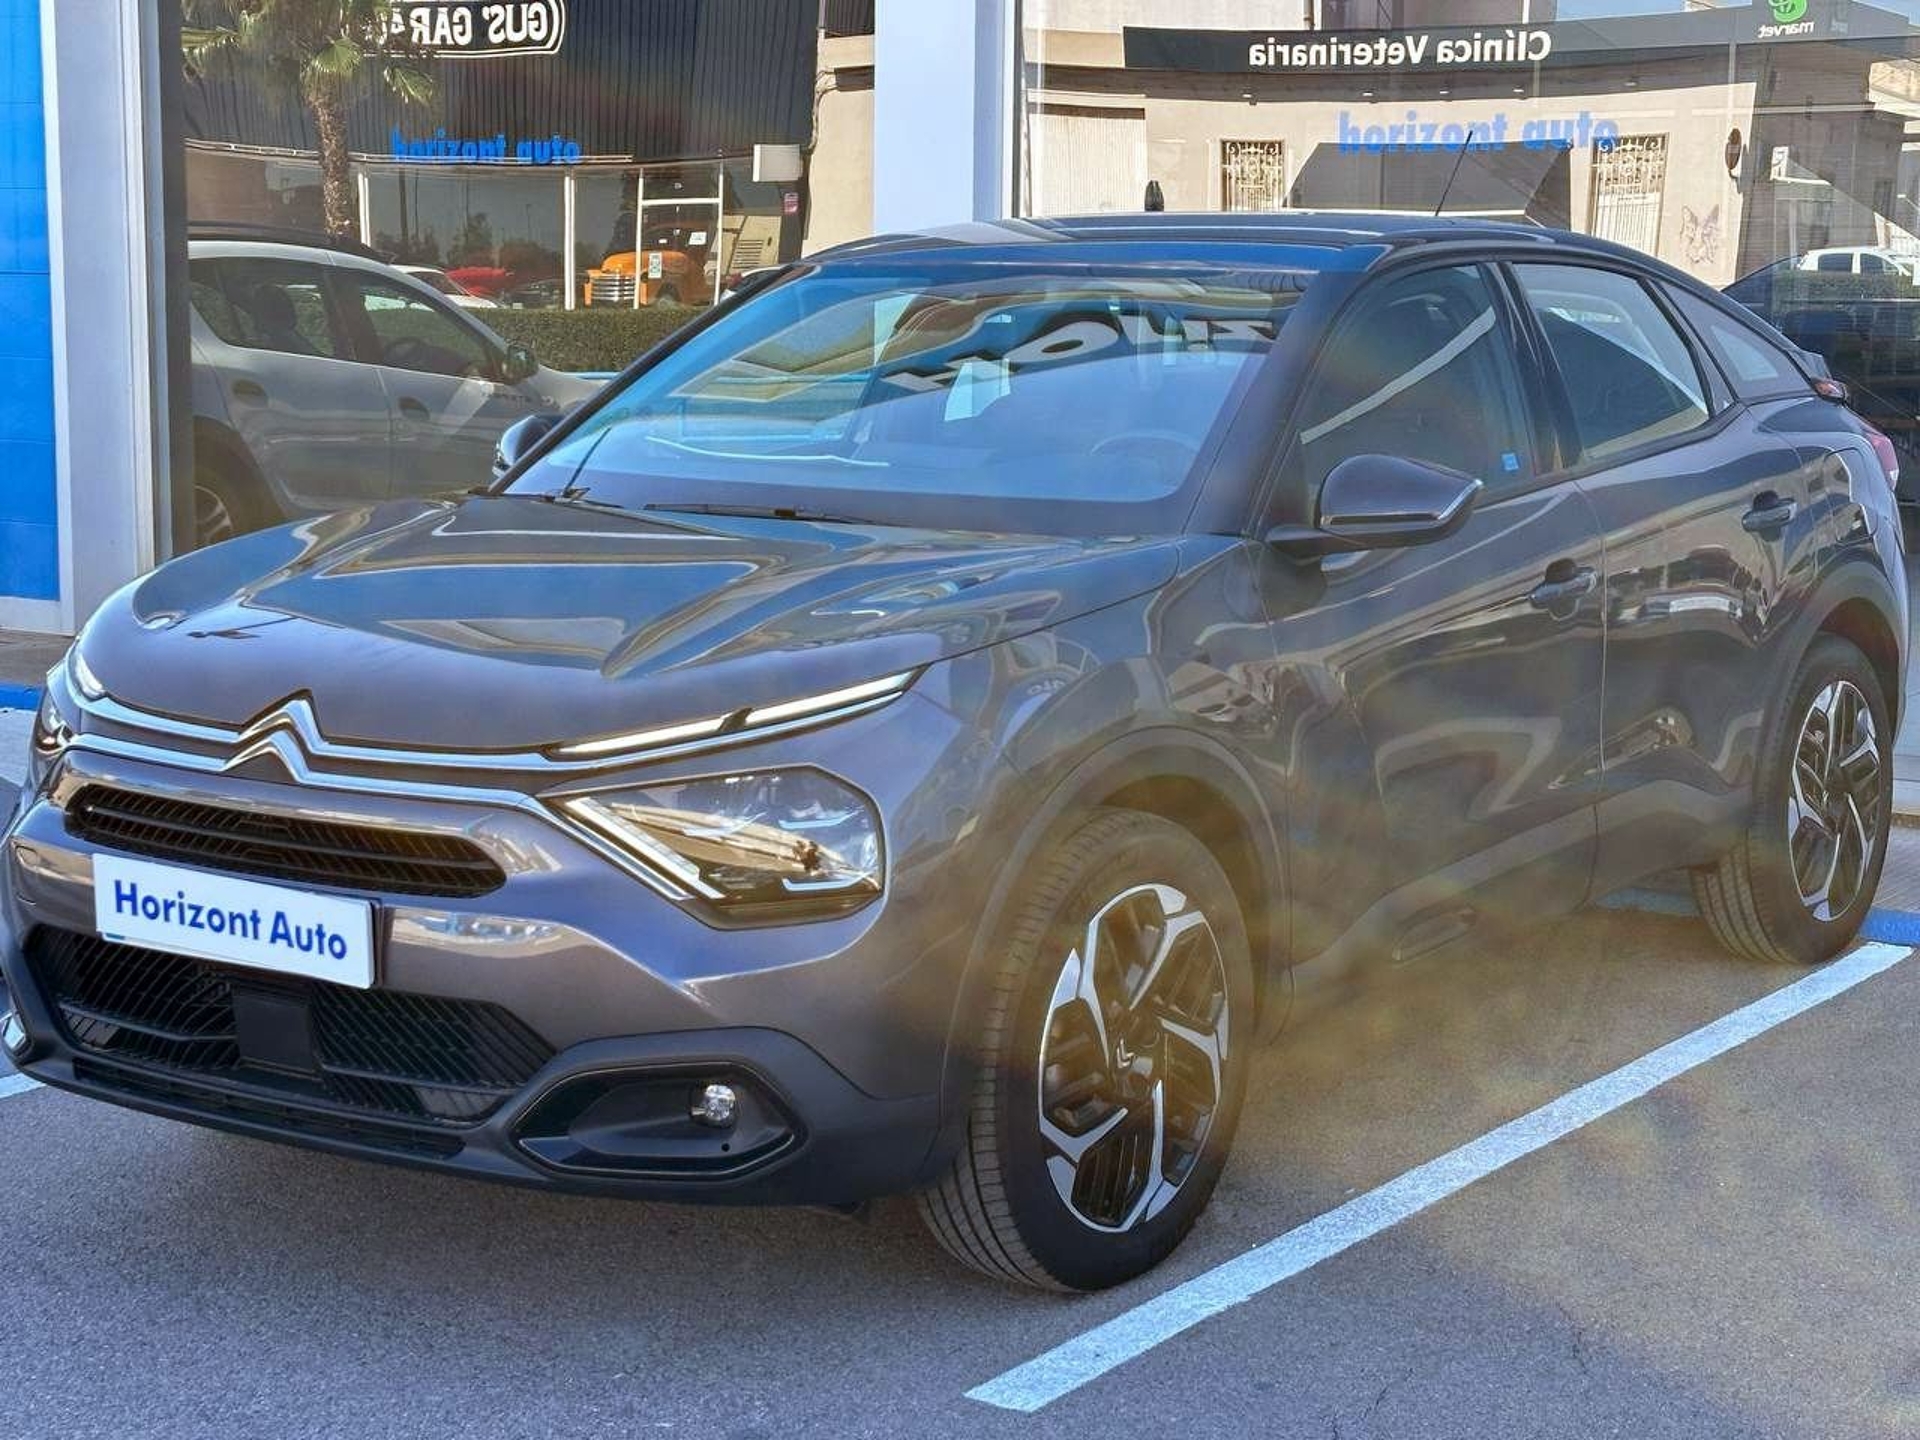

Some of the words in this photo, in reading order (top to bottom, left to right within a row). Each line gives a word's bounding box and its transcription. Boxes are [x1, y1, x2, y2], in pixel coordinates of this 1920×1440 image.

[1338, 110, 1508, 156] horizont
[1522, 110, 1620, 153] auto
[114, 879, 260, 940] Horizont
[269, 911, 347, 960] Auto
